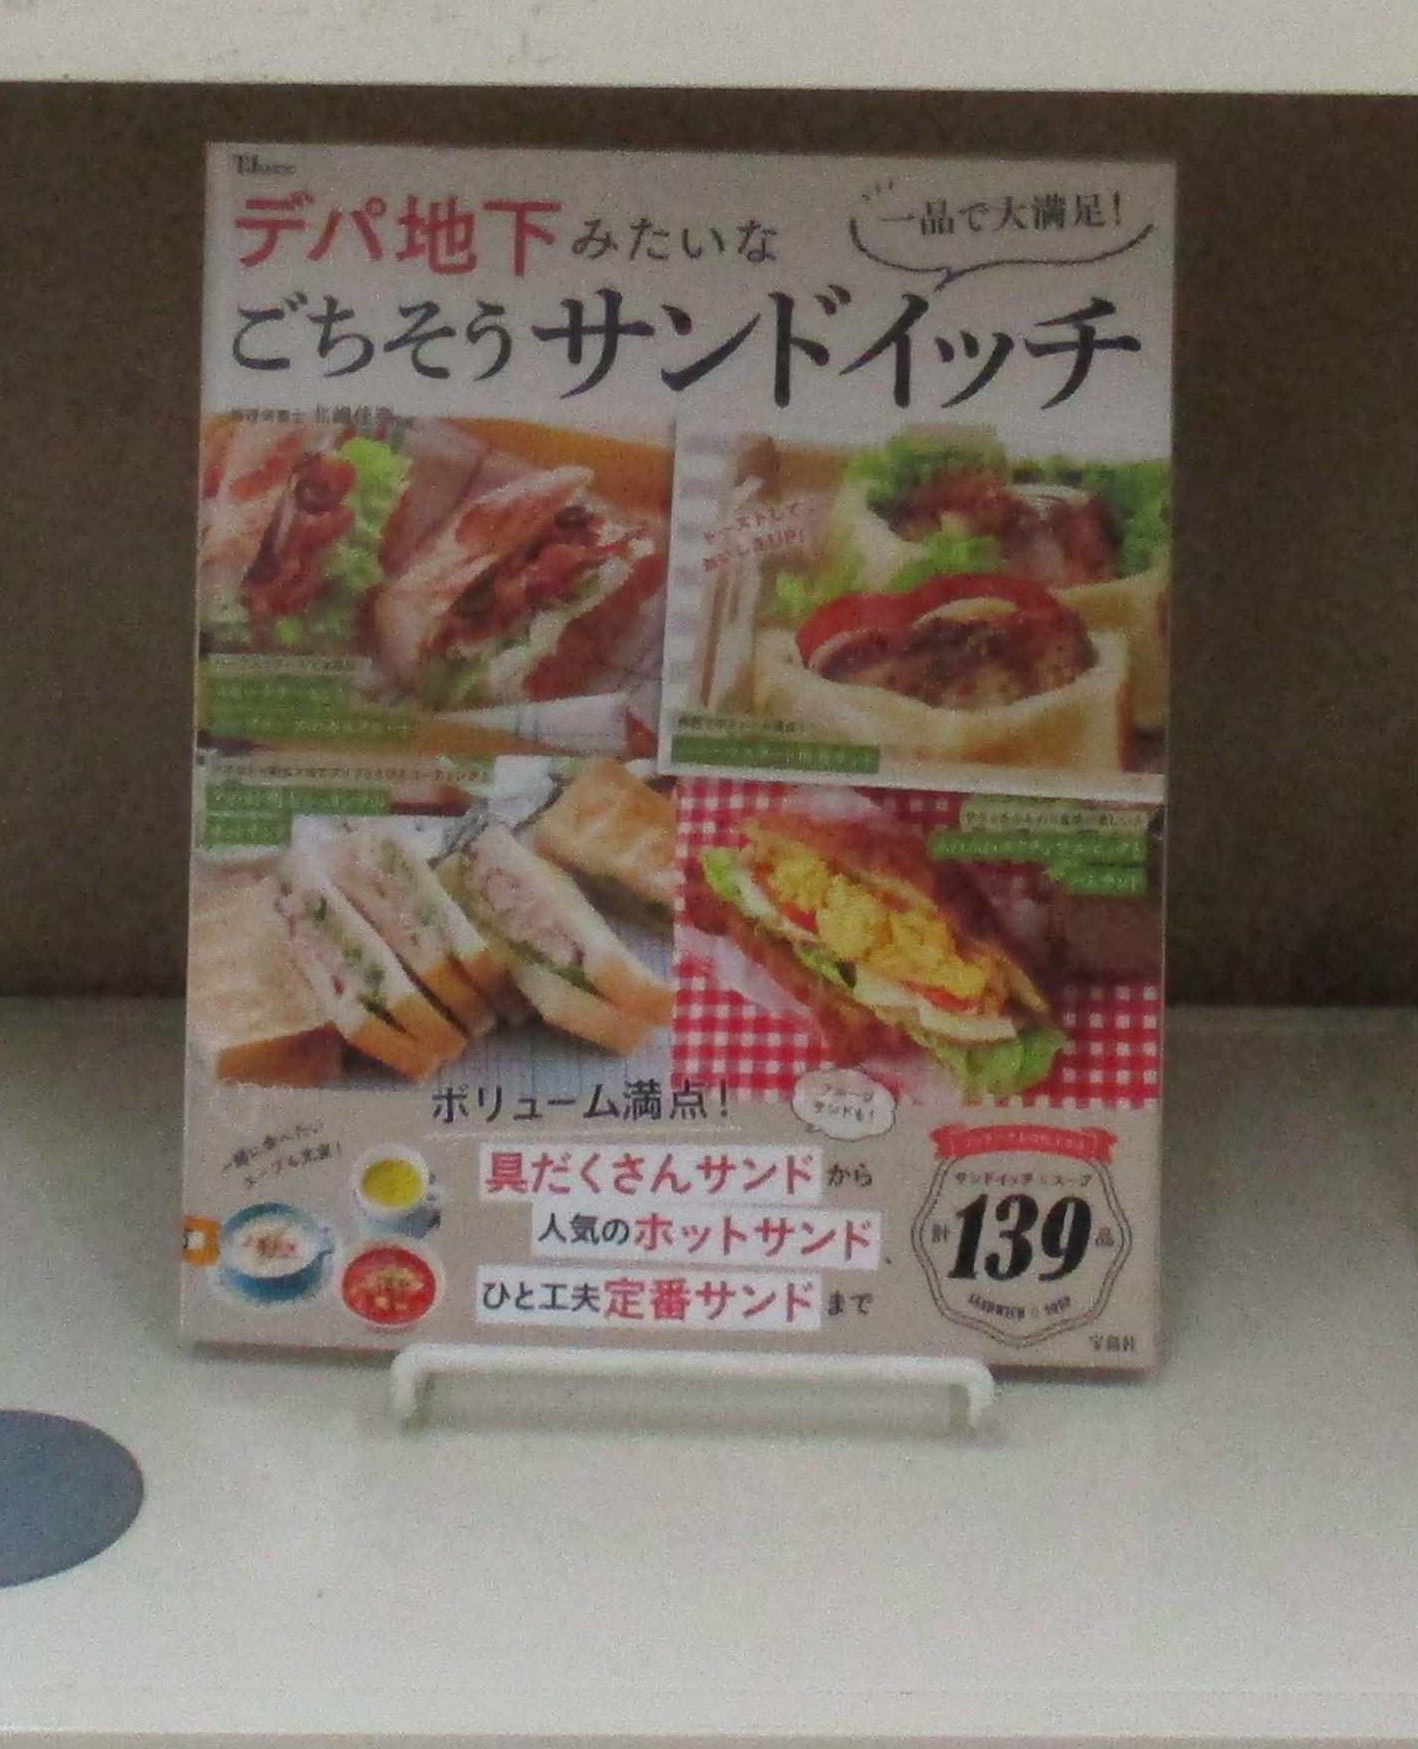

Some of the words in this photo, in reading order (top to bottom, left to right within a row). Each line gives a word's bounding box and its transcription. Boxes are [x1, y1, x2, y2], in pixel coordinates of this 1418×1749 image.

[235, 190, 778, 277] デパ地下みたいな
[232, 284, 1143, 410] ごちそうサンドイッチ
[431, 1081, 730, 1126] ボリューム満点!
[947, 1192, 1092, 1282] 139
